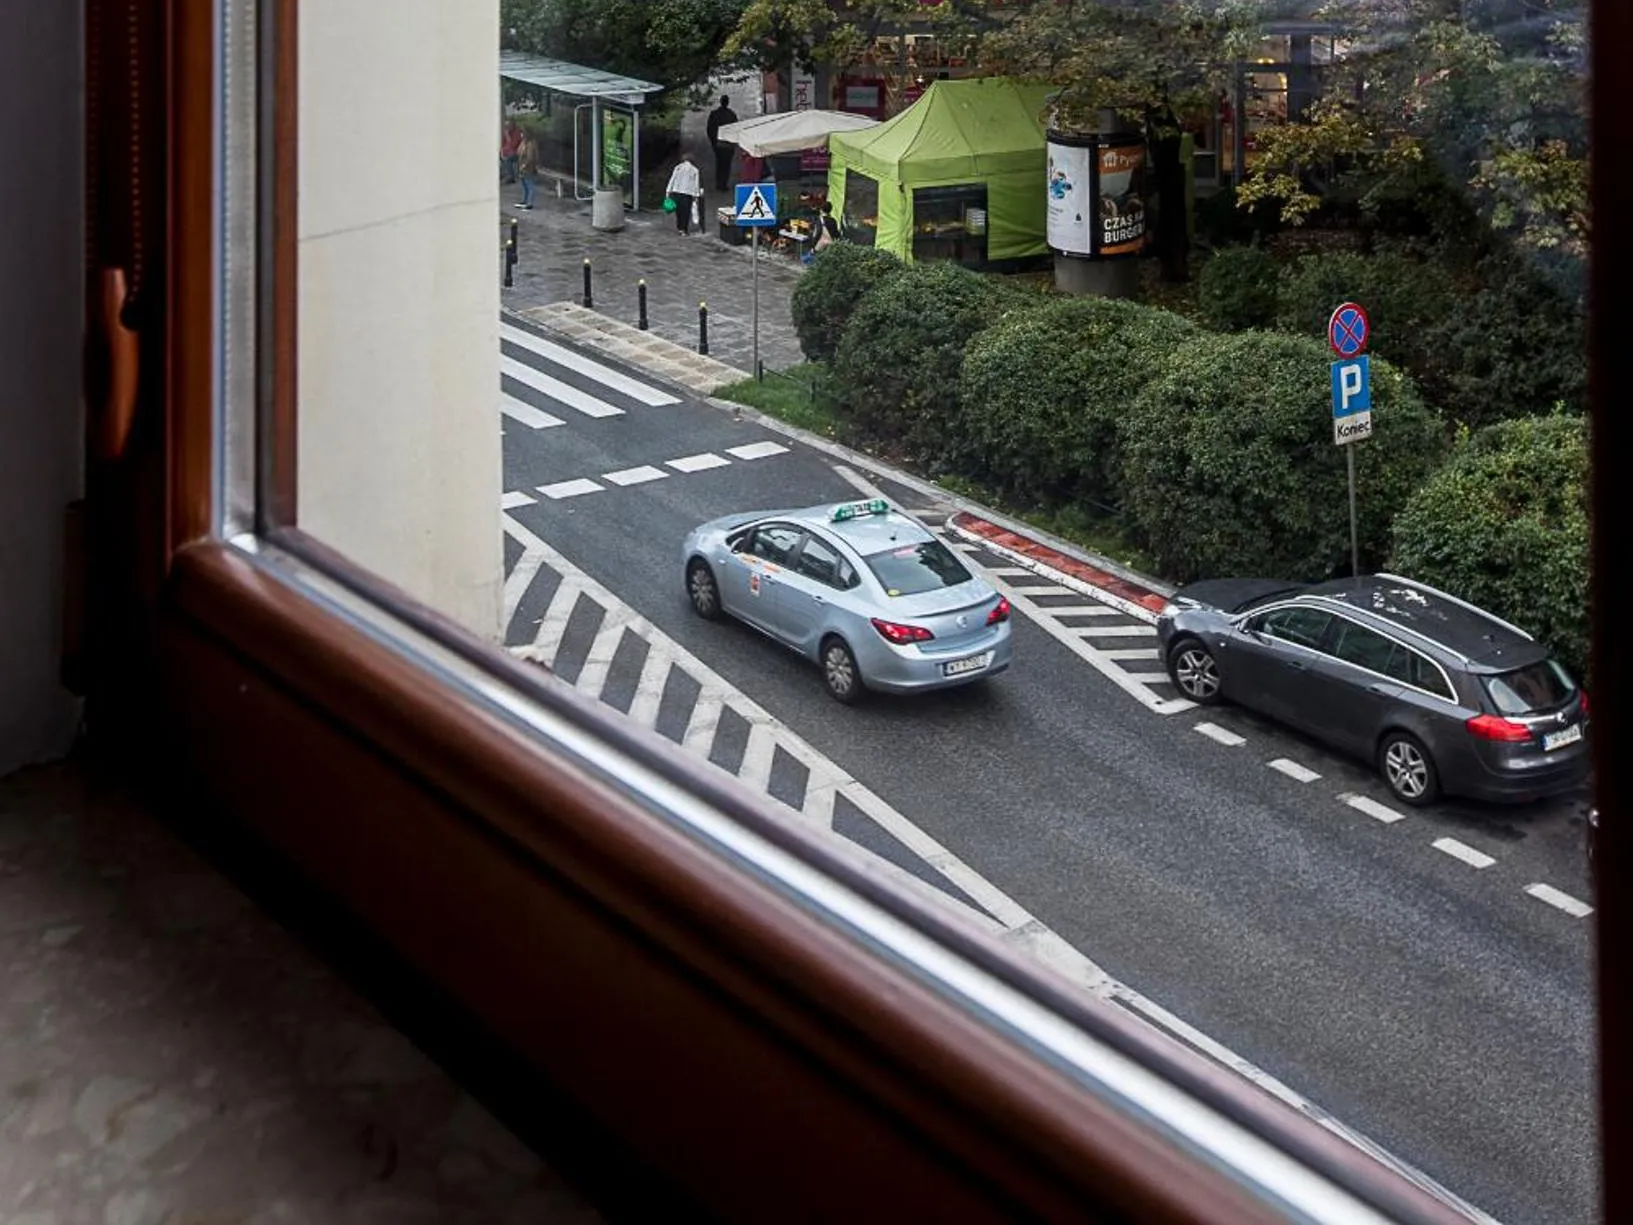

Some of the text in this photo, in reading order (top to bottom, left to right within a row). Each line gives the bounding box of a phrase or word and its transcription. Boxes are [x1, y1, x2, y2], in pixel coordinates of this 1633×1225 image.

[1104, 214, 1133, 230] CZAS
[1340, 364, 1361, 409] P
[1337, 421, 1370, 439] Koniec
